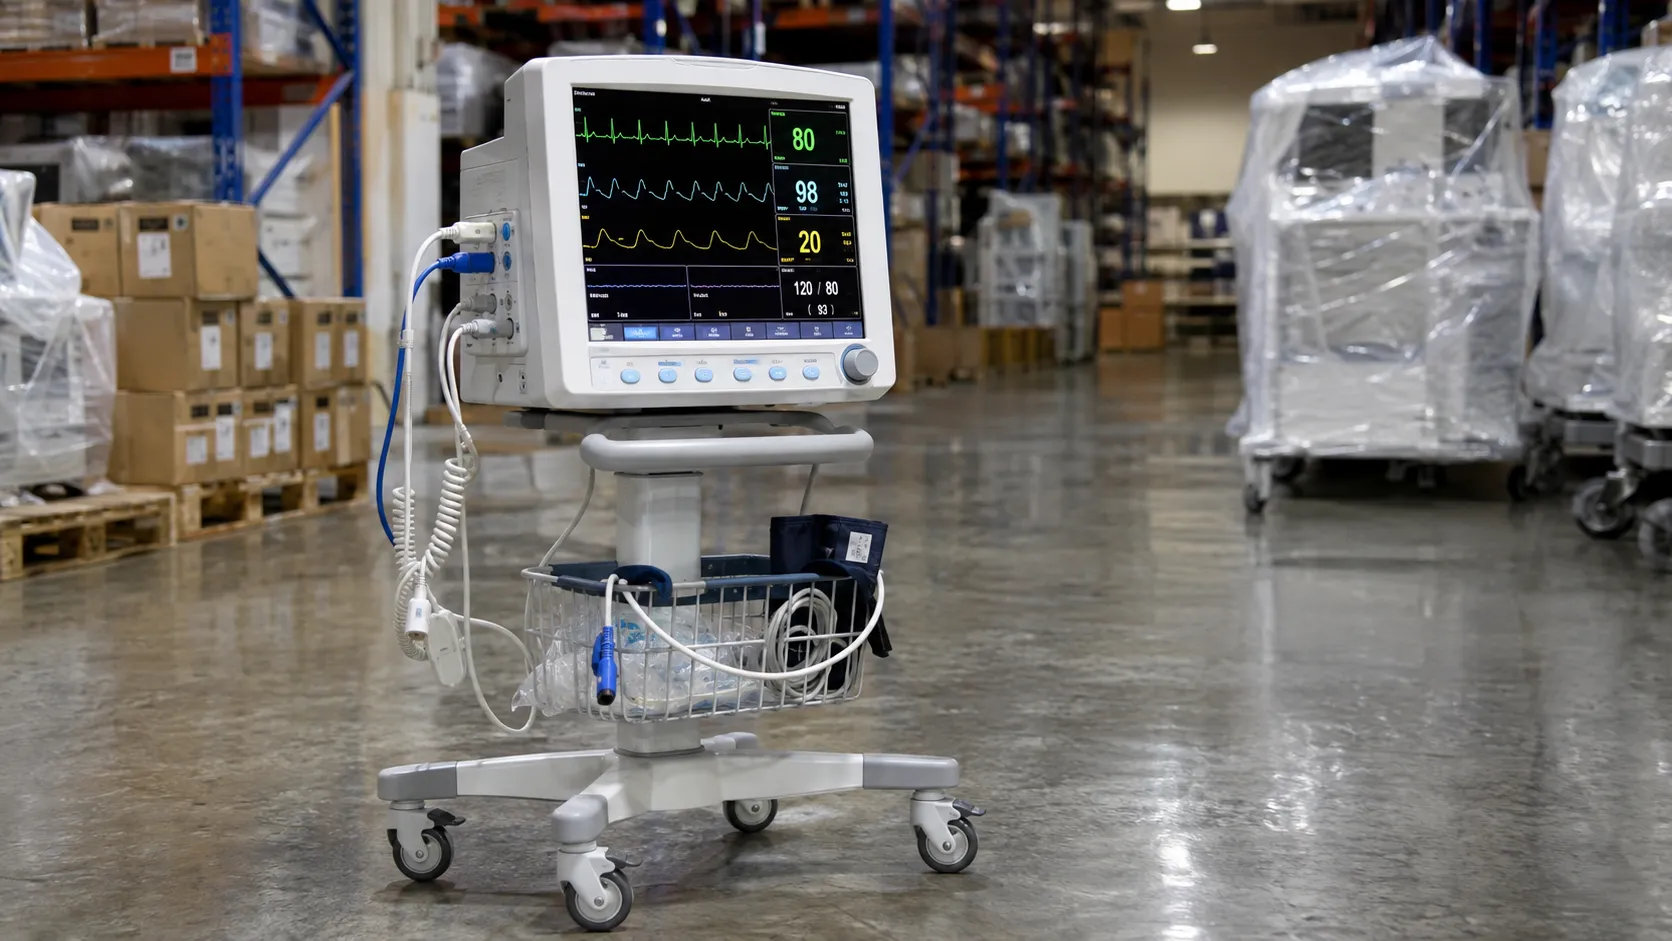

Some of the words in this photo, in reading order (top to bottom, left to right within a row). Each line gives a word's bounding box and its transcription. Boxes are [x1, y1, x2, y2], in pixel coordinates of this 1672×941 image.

[792, 127, 815, 151] 80
[795, 180, 819, 204] 98
[798, 230, 821, 254] 20
[793, 280, 813, 296] 120
[825, 280, 839, 296] 80
